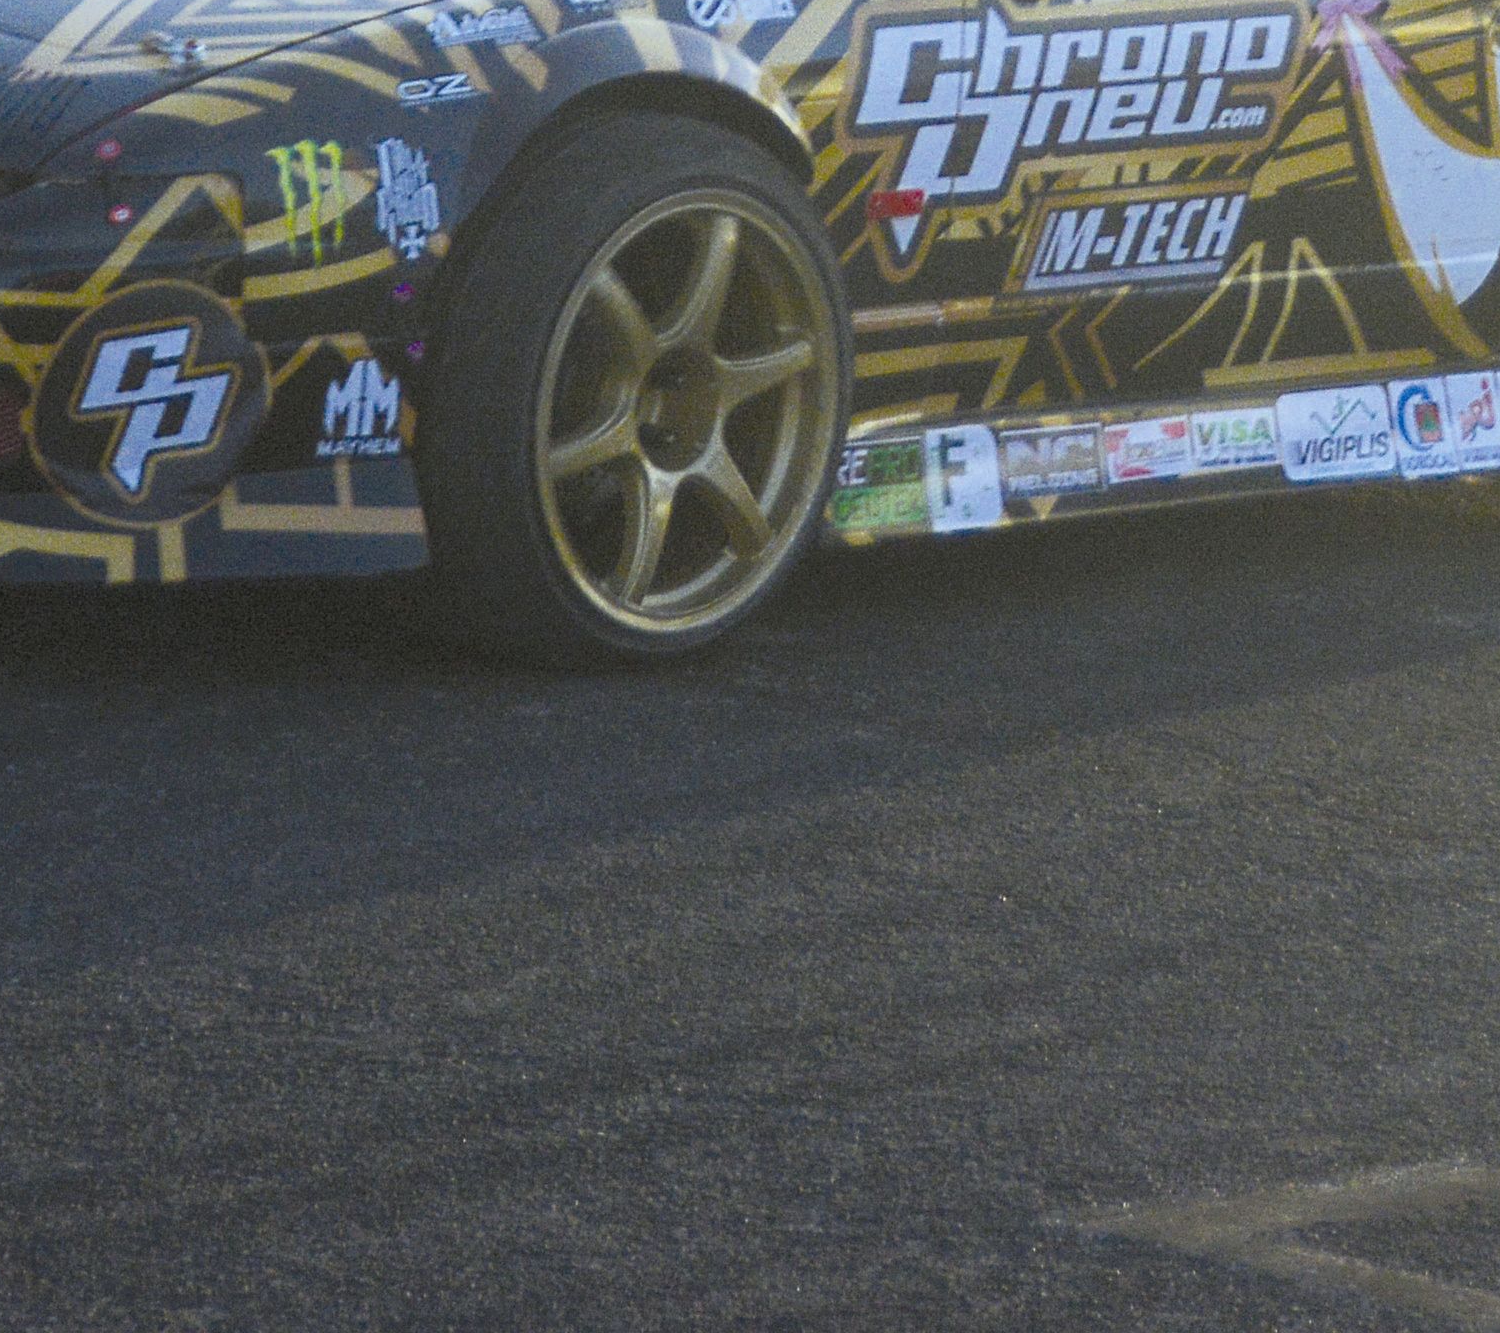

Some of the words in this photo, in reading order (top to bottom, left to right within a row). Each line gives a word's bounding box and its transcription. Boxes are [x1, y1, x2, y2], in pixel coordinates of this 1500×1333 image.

[855, 7, 1294, 126] Chrono
[1043, 195, 1248, 274] M-TECH
[1197, 418, 1273, 447] VISA
